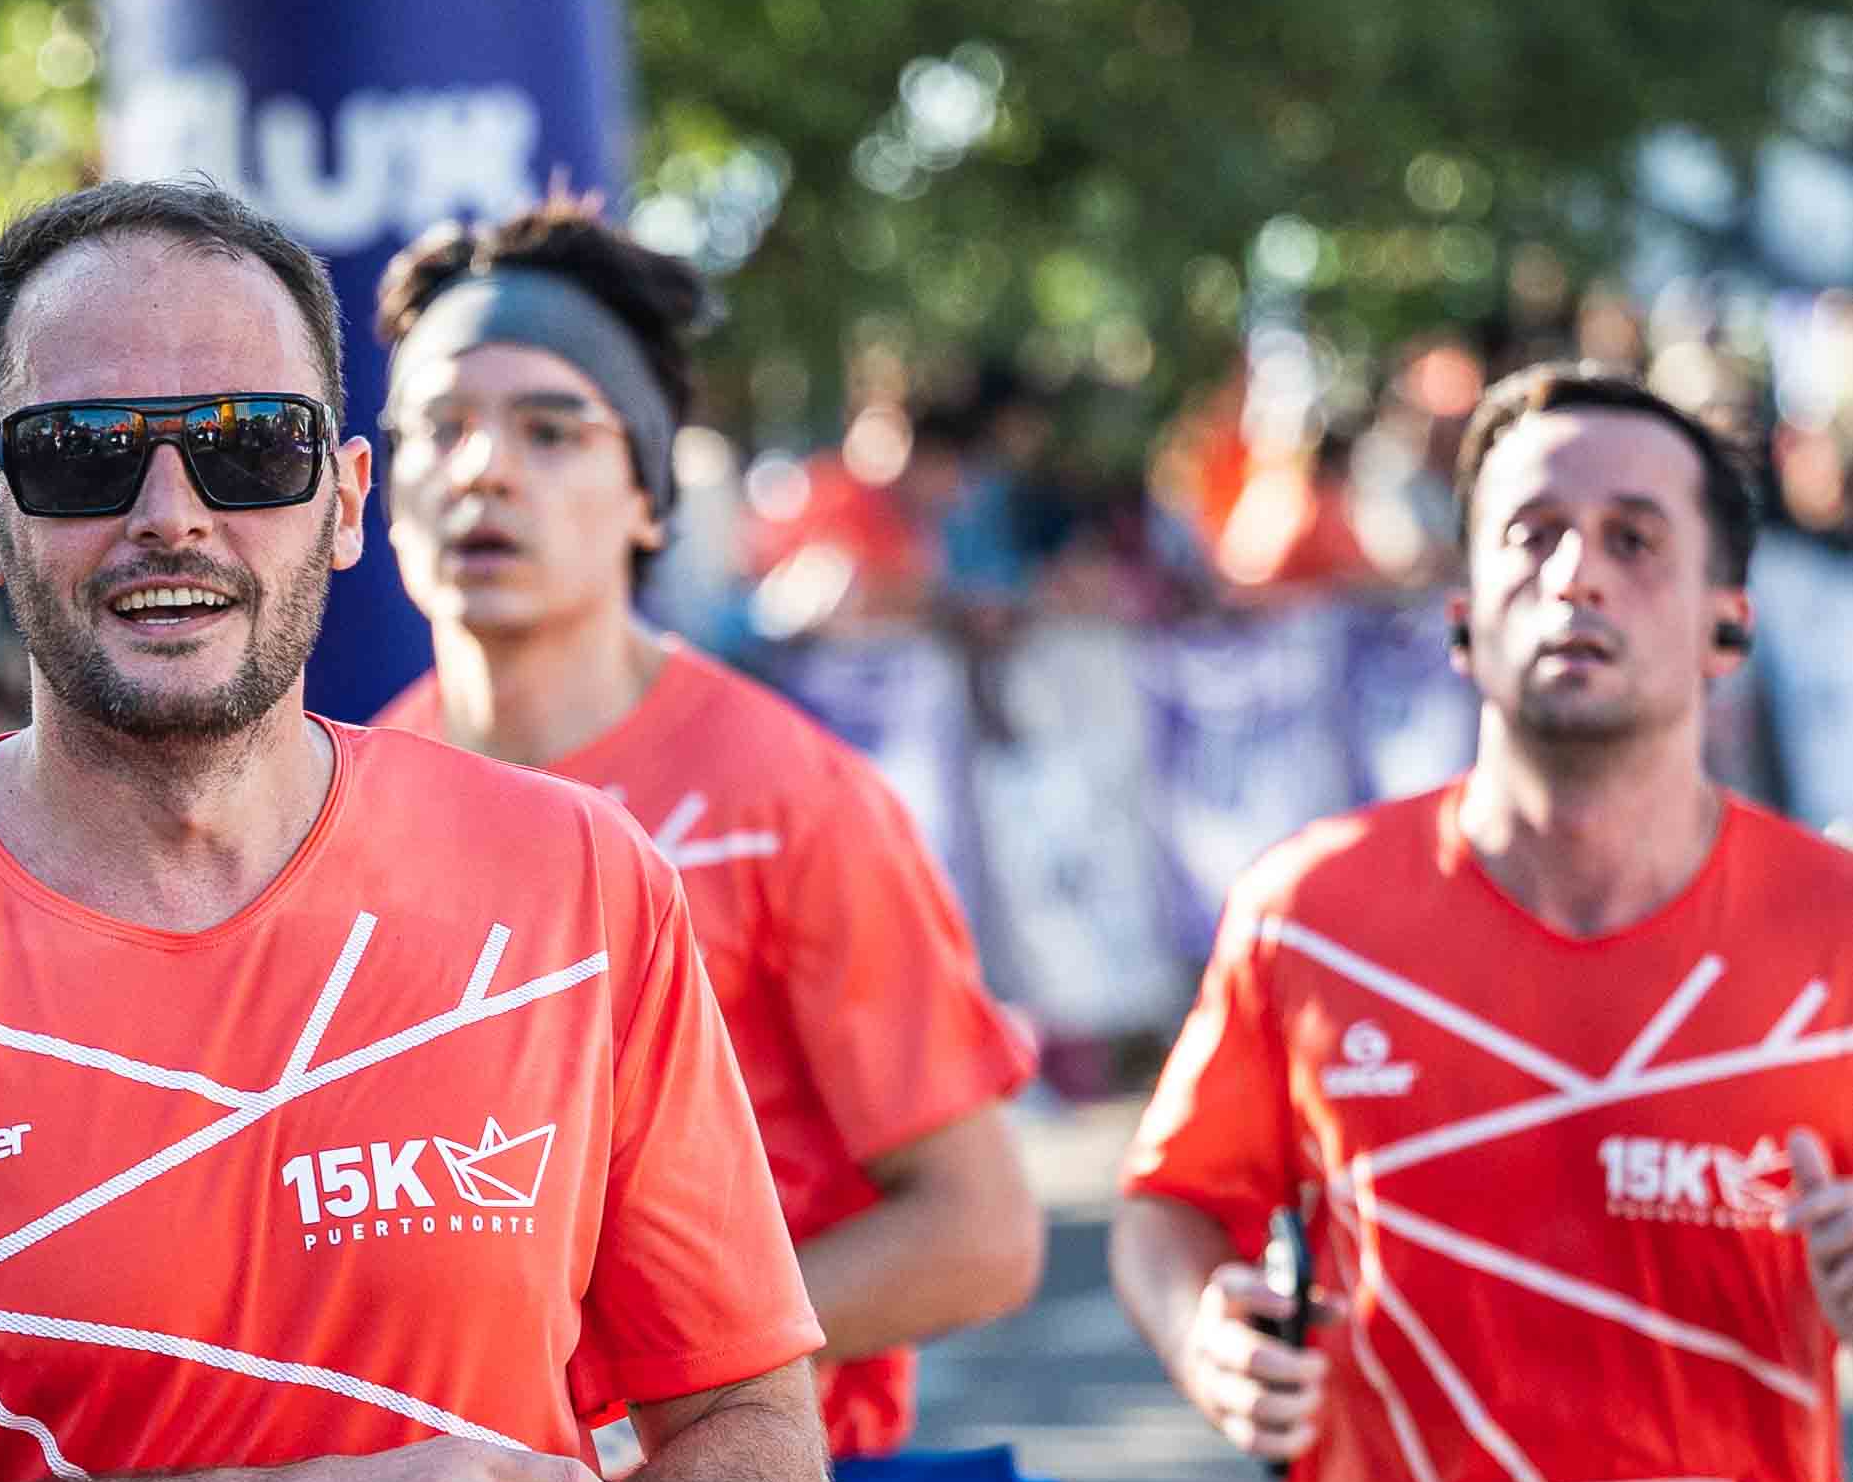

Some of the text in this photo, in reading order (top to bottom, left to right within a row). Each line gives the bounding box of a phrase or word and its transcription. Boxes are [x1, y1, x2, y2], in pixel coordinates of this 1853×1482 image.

[281, 1139, 436, 1225] 15K
[1598, 1135, 1710, 1206] 15K
[304, 1215, 536, 1251] PUERTO NORTE
